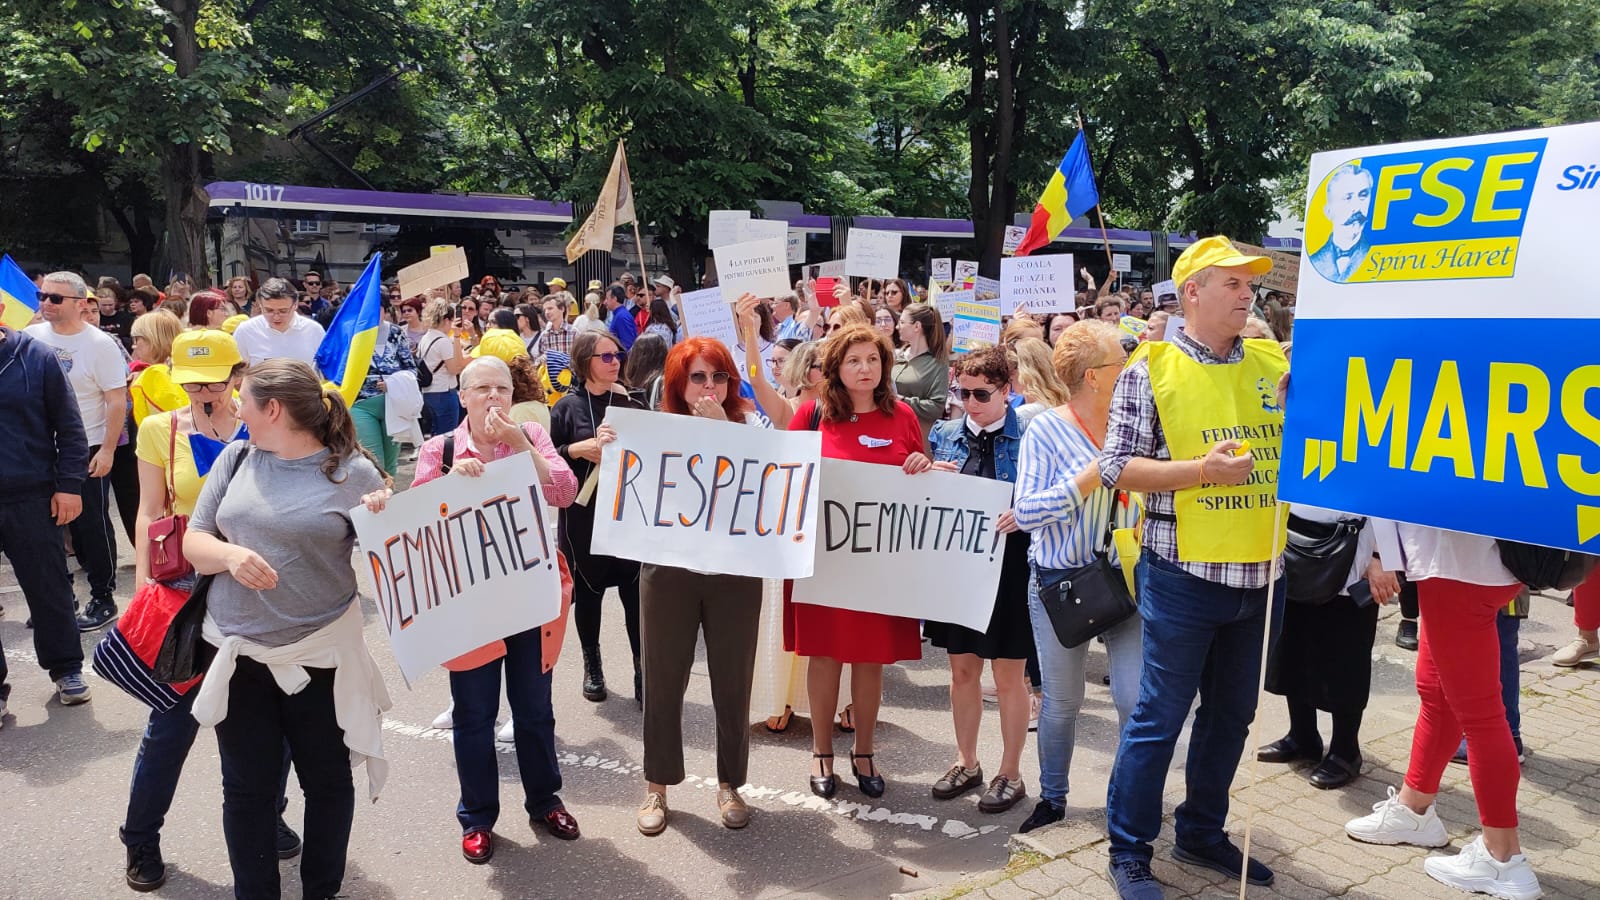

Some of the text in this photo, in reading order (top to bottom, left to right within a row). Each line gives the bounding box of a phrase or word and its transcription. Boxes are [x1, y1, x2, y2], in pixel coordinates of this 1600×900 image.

[244, 183, 285, 201] 1017
[1371, 151, 1539, 231] FSE
[1013, 274, 1025, 283] DE
[1367, 243, 1513, 280] Spiru Haret
[612, 448, 815, 544] RESPECT!
[823, 496, 1003, 562] DEMNITATE!
[366, 484, 553, 636] DEMNITATE!
